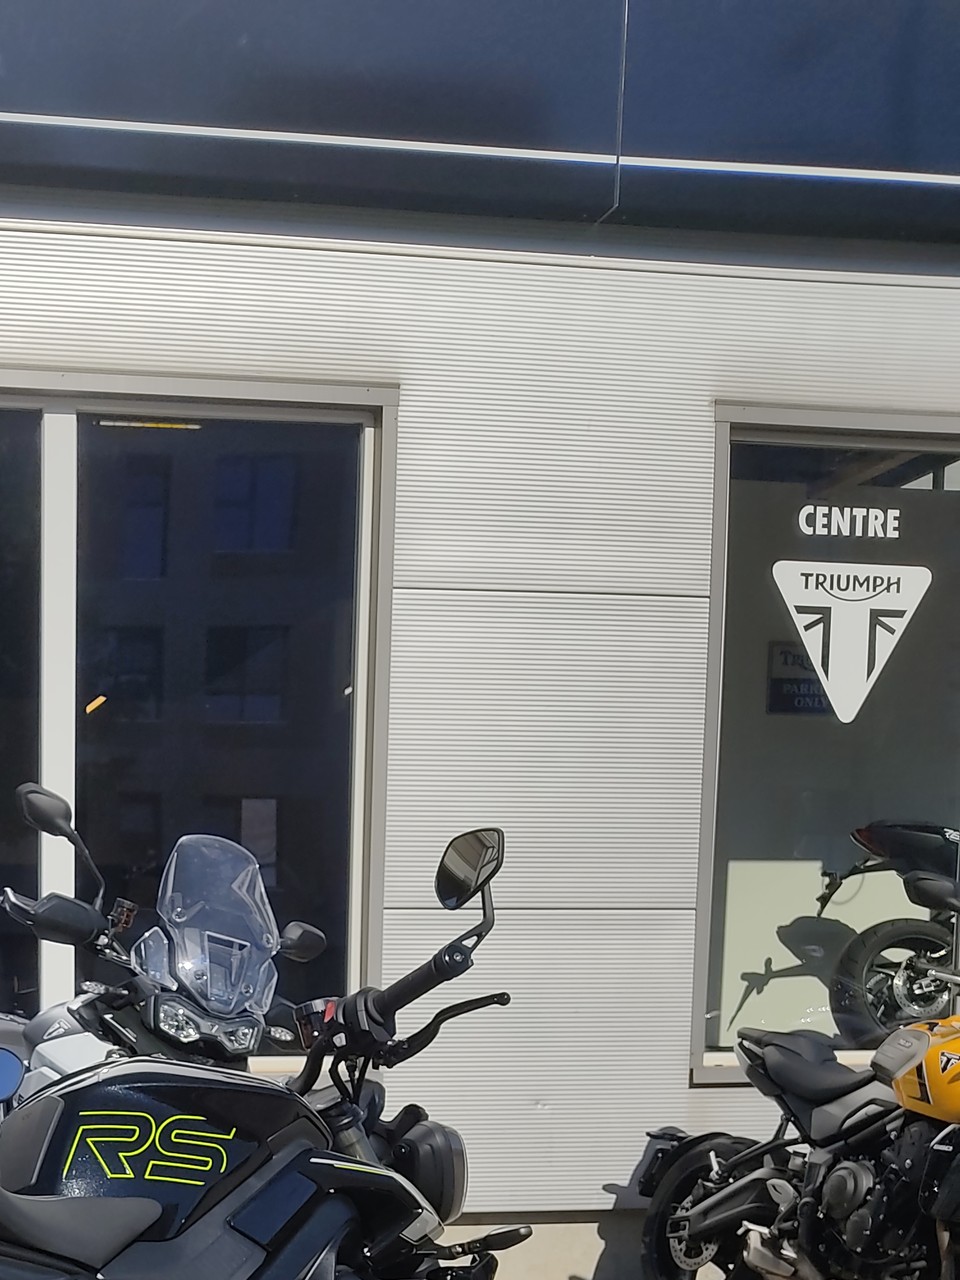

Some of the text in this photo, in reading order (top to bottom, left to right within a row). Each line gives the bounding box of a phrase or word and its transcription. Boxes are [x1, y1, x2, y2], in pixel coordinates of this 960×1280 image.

[798, 504, 901, 538] CENTRE
[800, 572, 902, 598] TRIUMPH
[62, 1111, 237, 1186] RS
